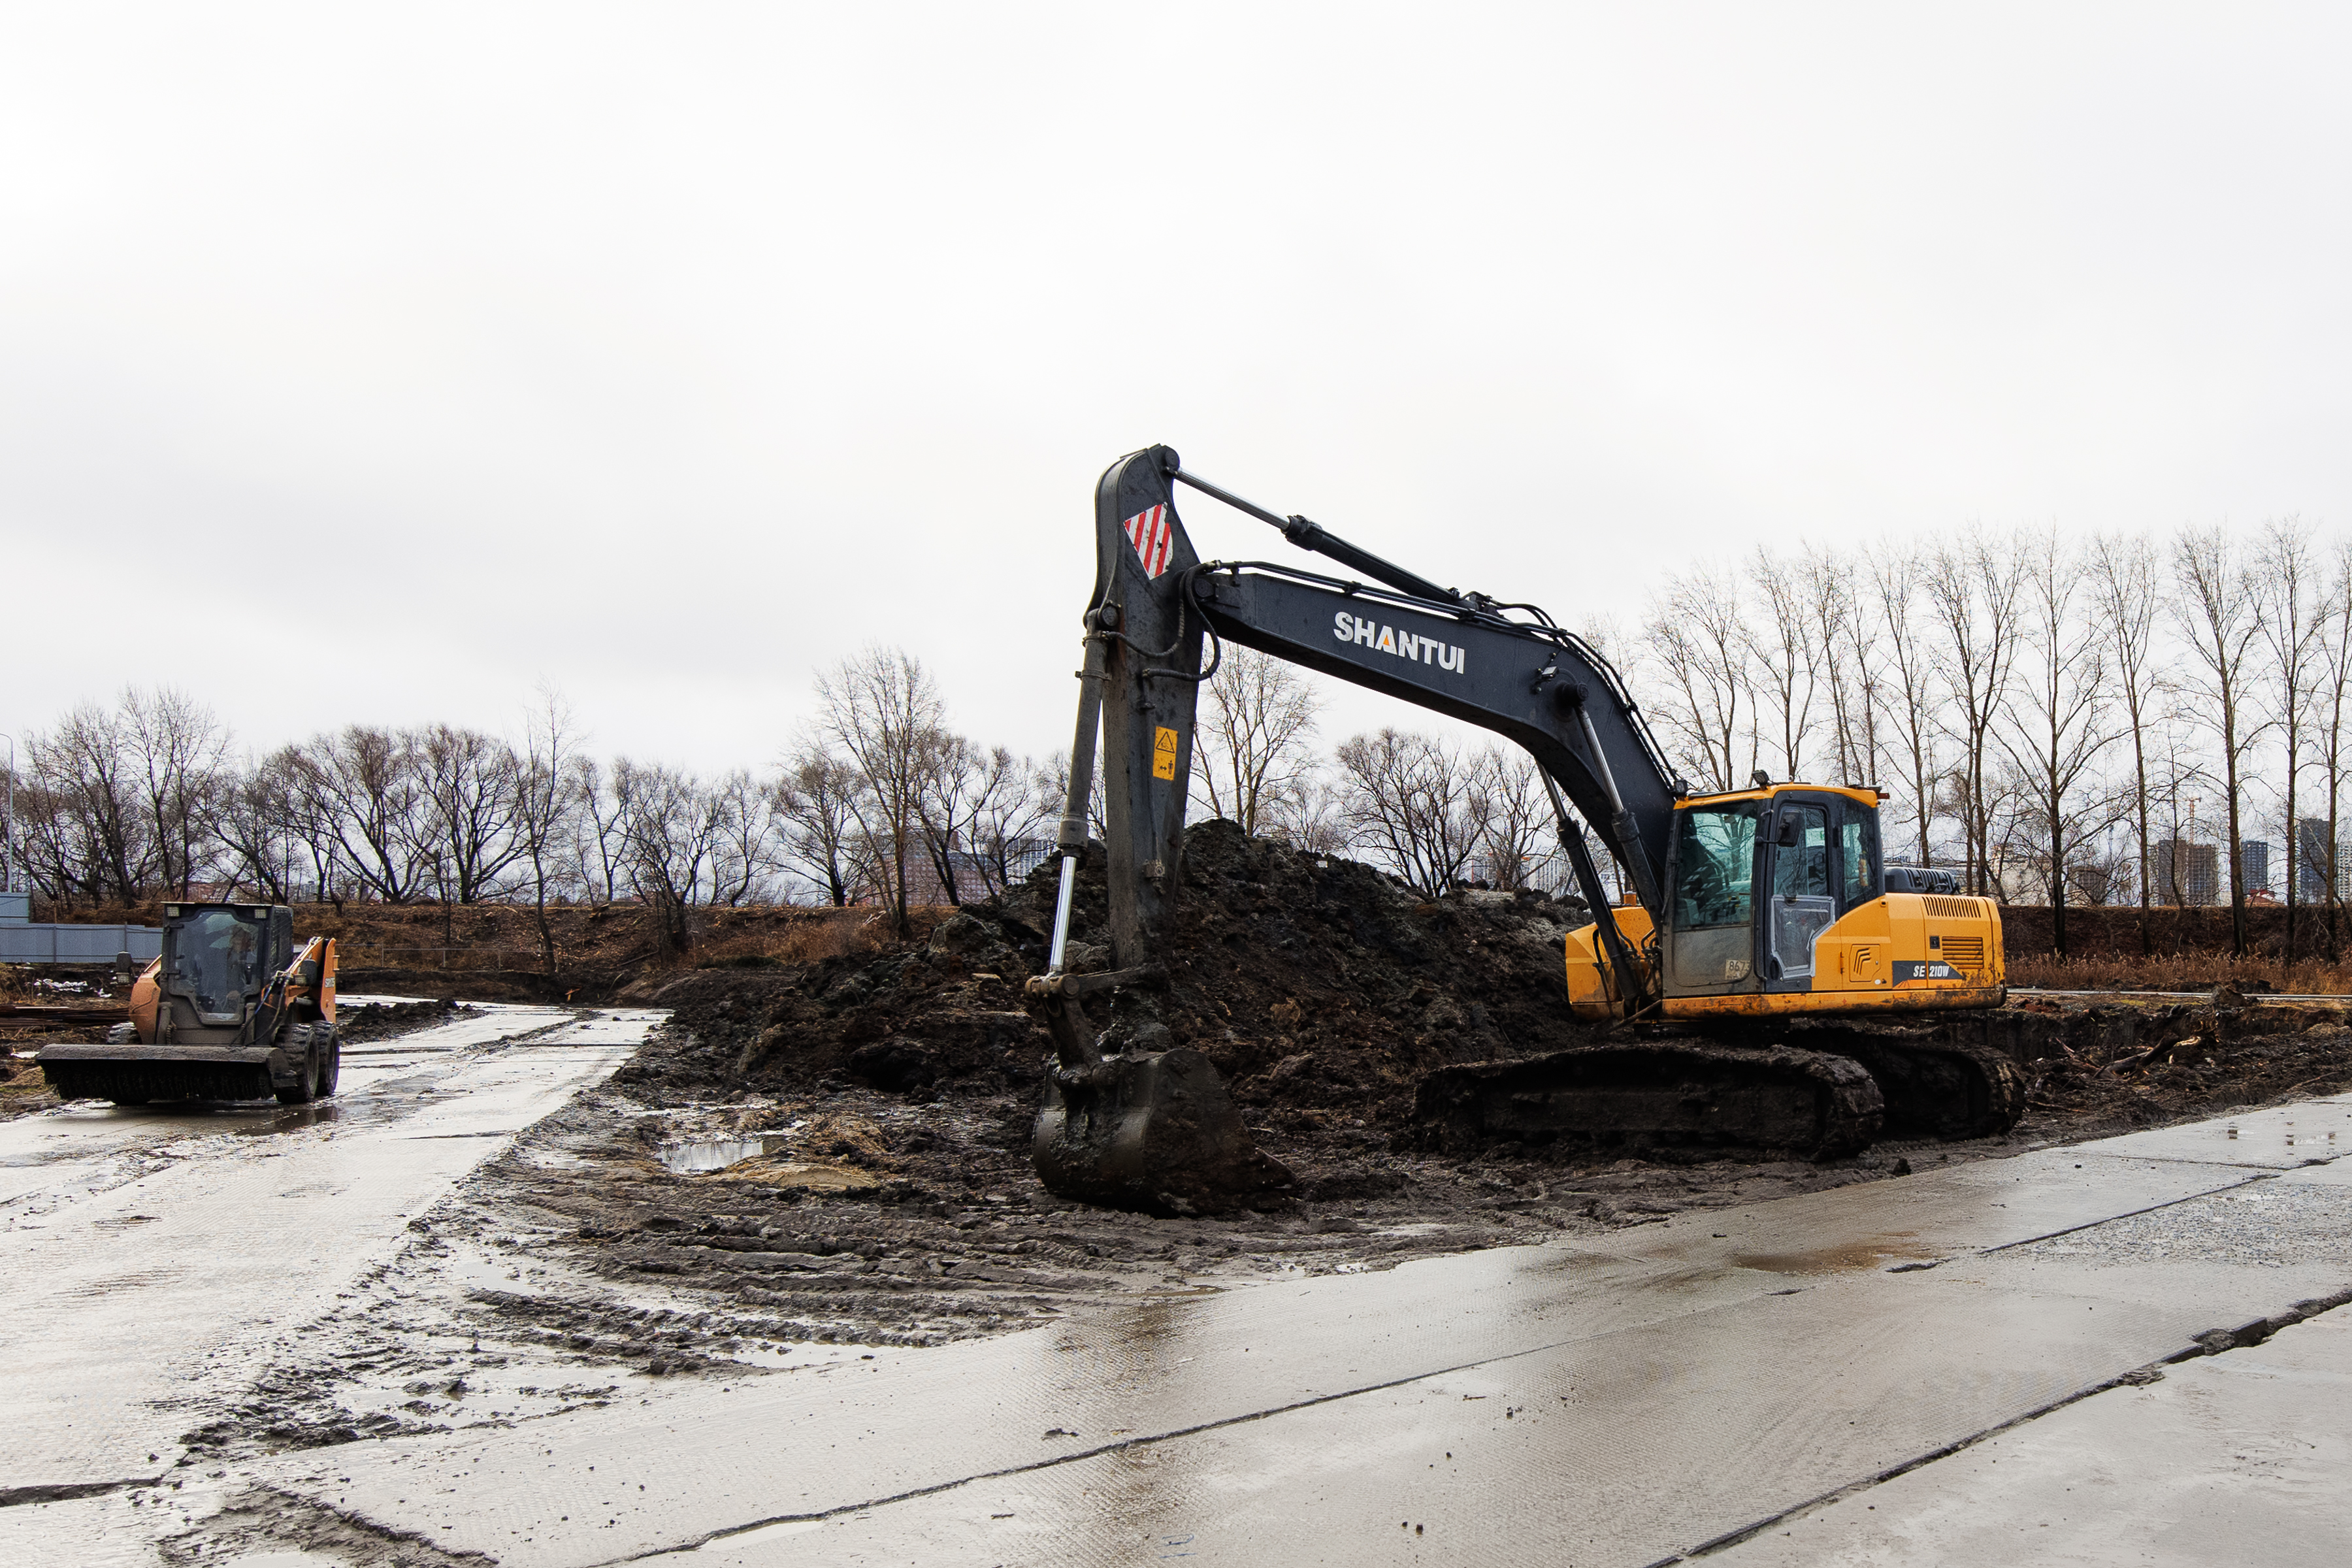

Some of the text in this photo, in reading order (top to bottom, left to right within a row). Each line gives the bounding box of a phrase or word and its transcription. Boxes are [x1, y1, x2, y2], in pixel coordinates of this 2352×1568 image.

[1333, 612, 1465, 674] SHANTUI
[1913, 965, 1950, 977] SE 210W
